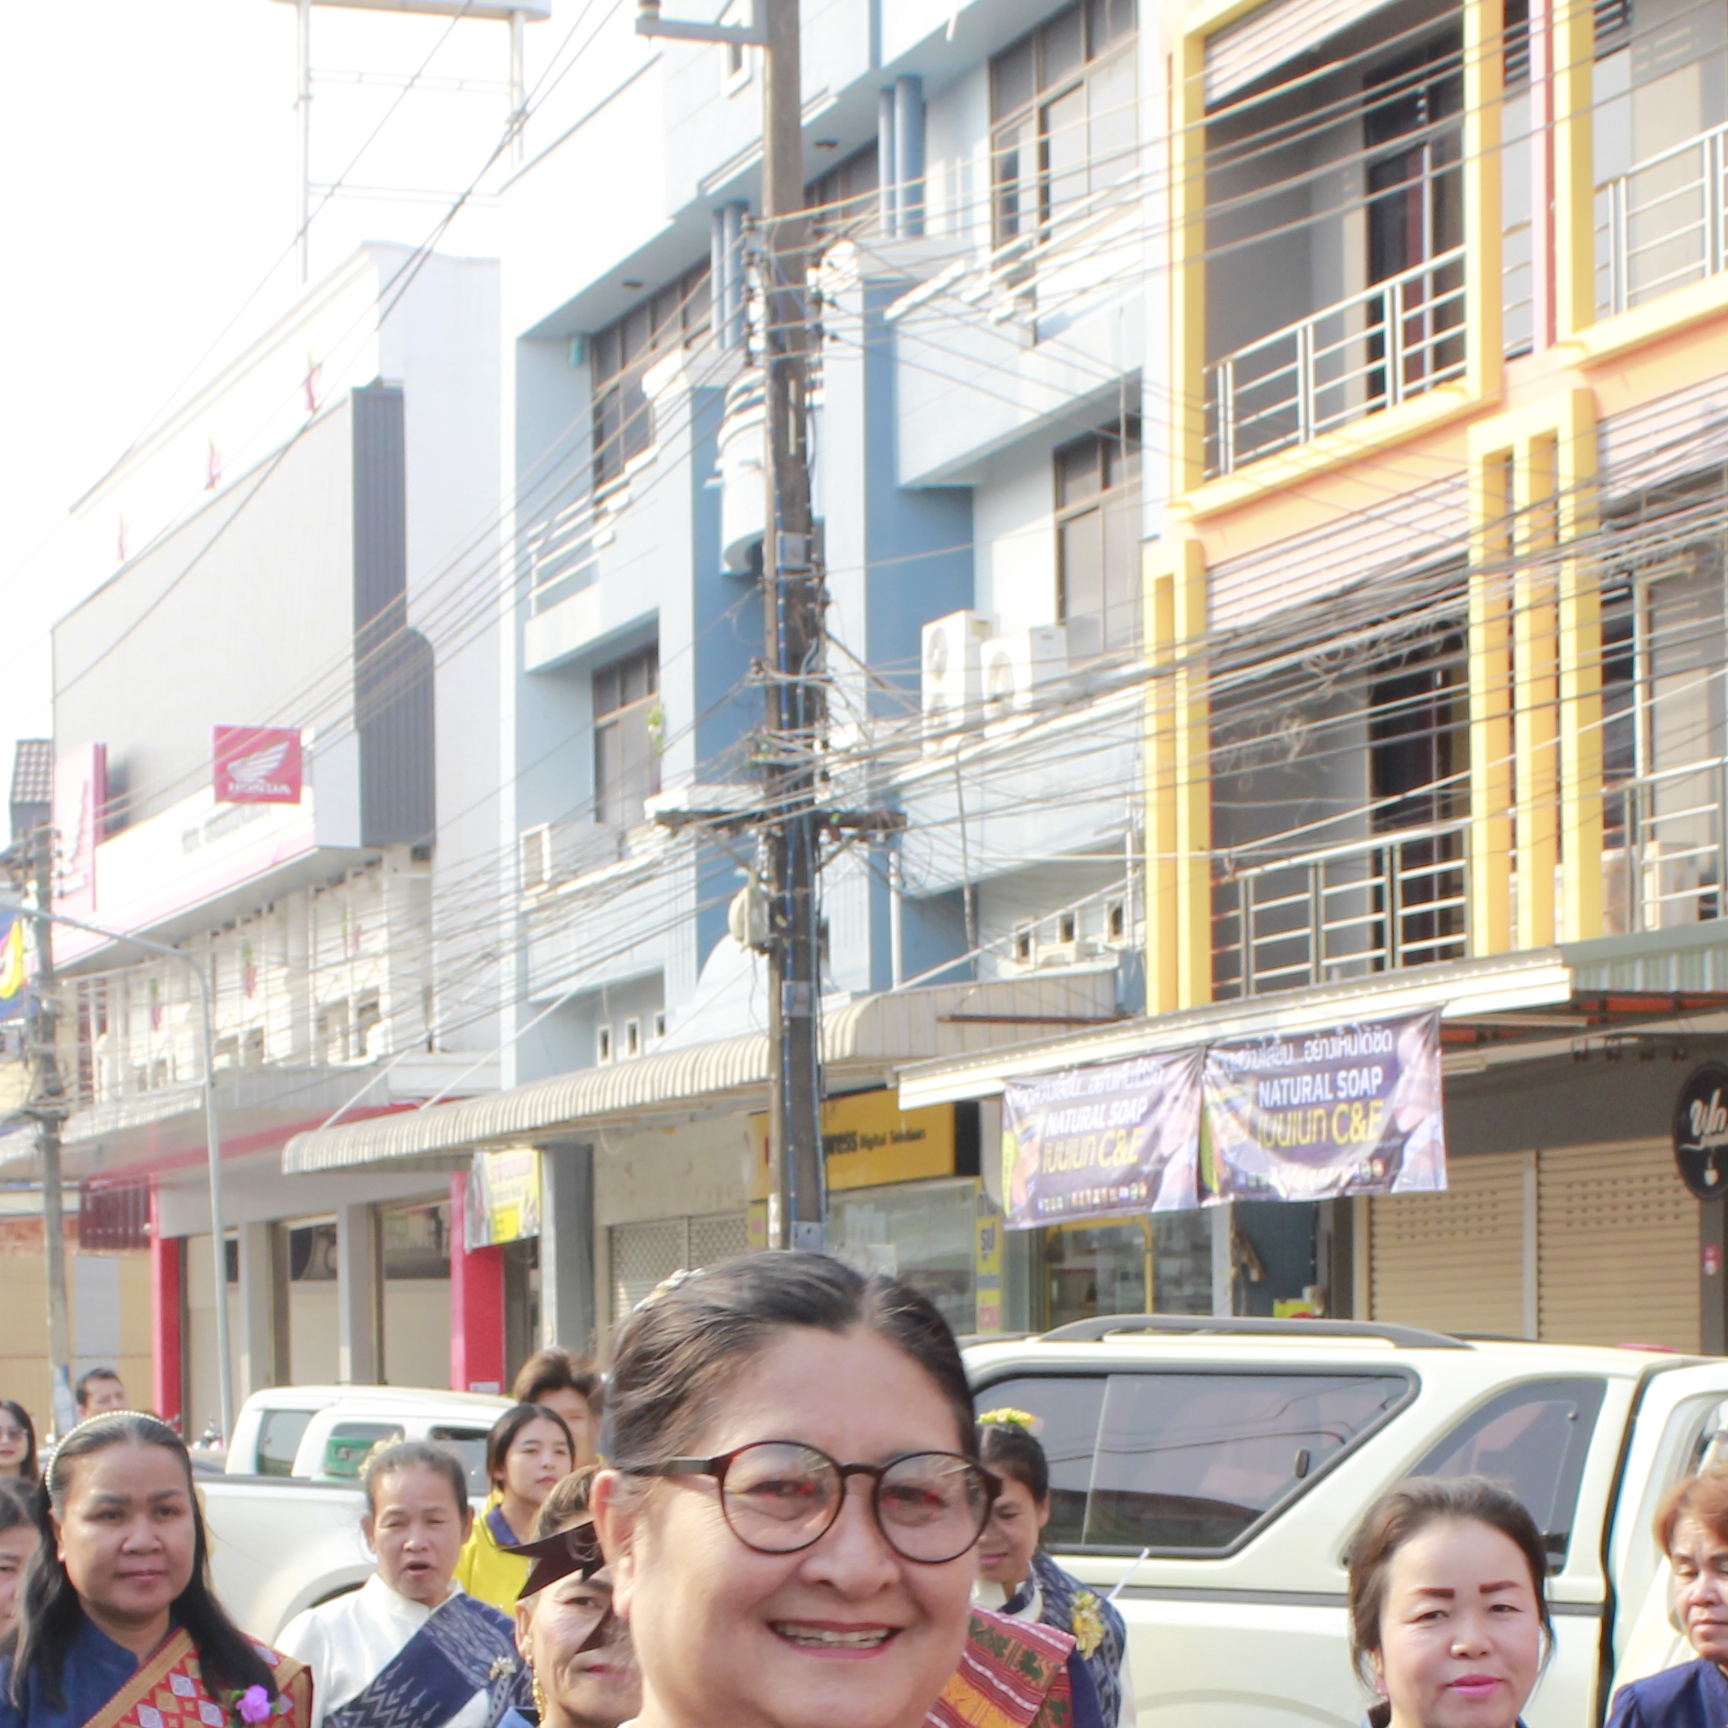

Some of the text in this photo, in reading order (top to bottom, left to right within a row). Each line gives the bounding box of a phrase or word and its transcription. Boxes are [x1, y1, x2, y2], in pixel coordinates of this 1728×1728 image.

[228, 782, 291, 795] HONDA
[1258, 1066, 1383, 1107] NATURAL SOAP
[1045, 1097, 1149, 1137] NATURAL SOAP
[1098, 1127, 1147, 1168] C&E
